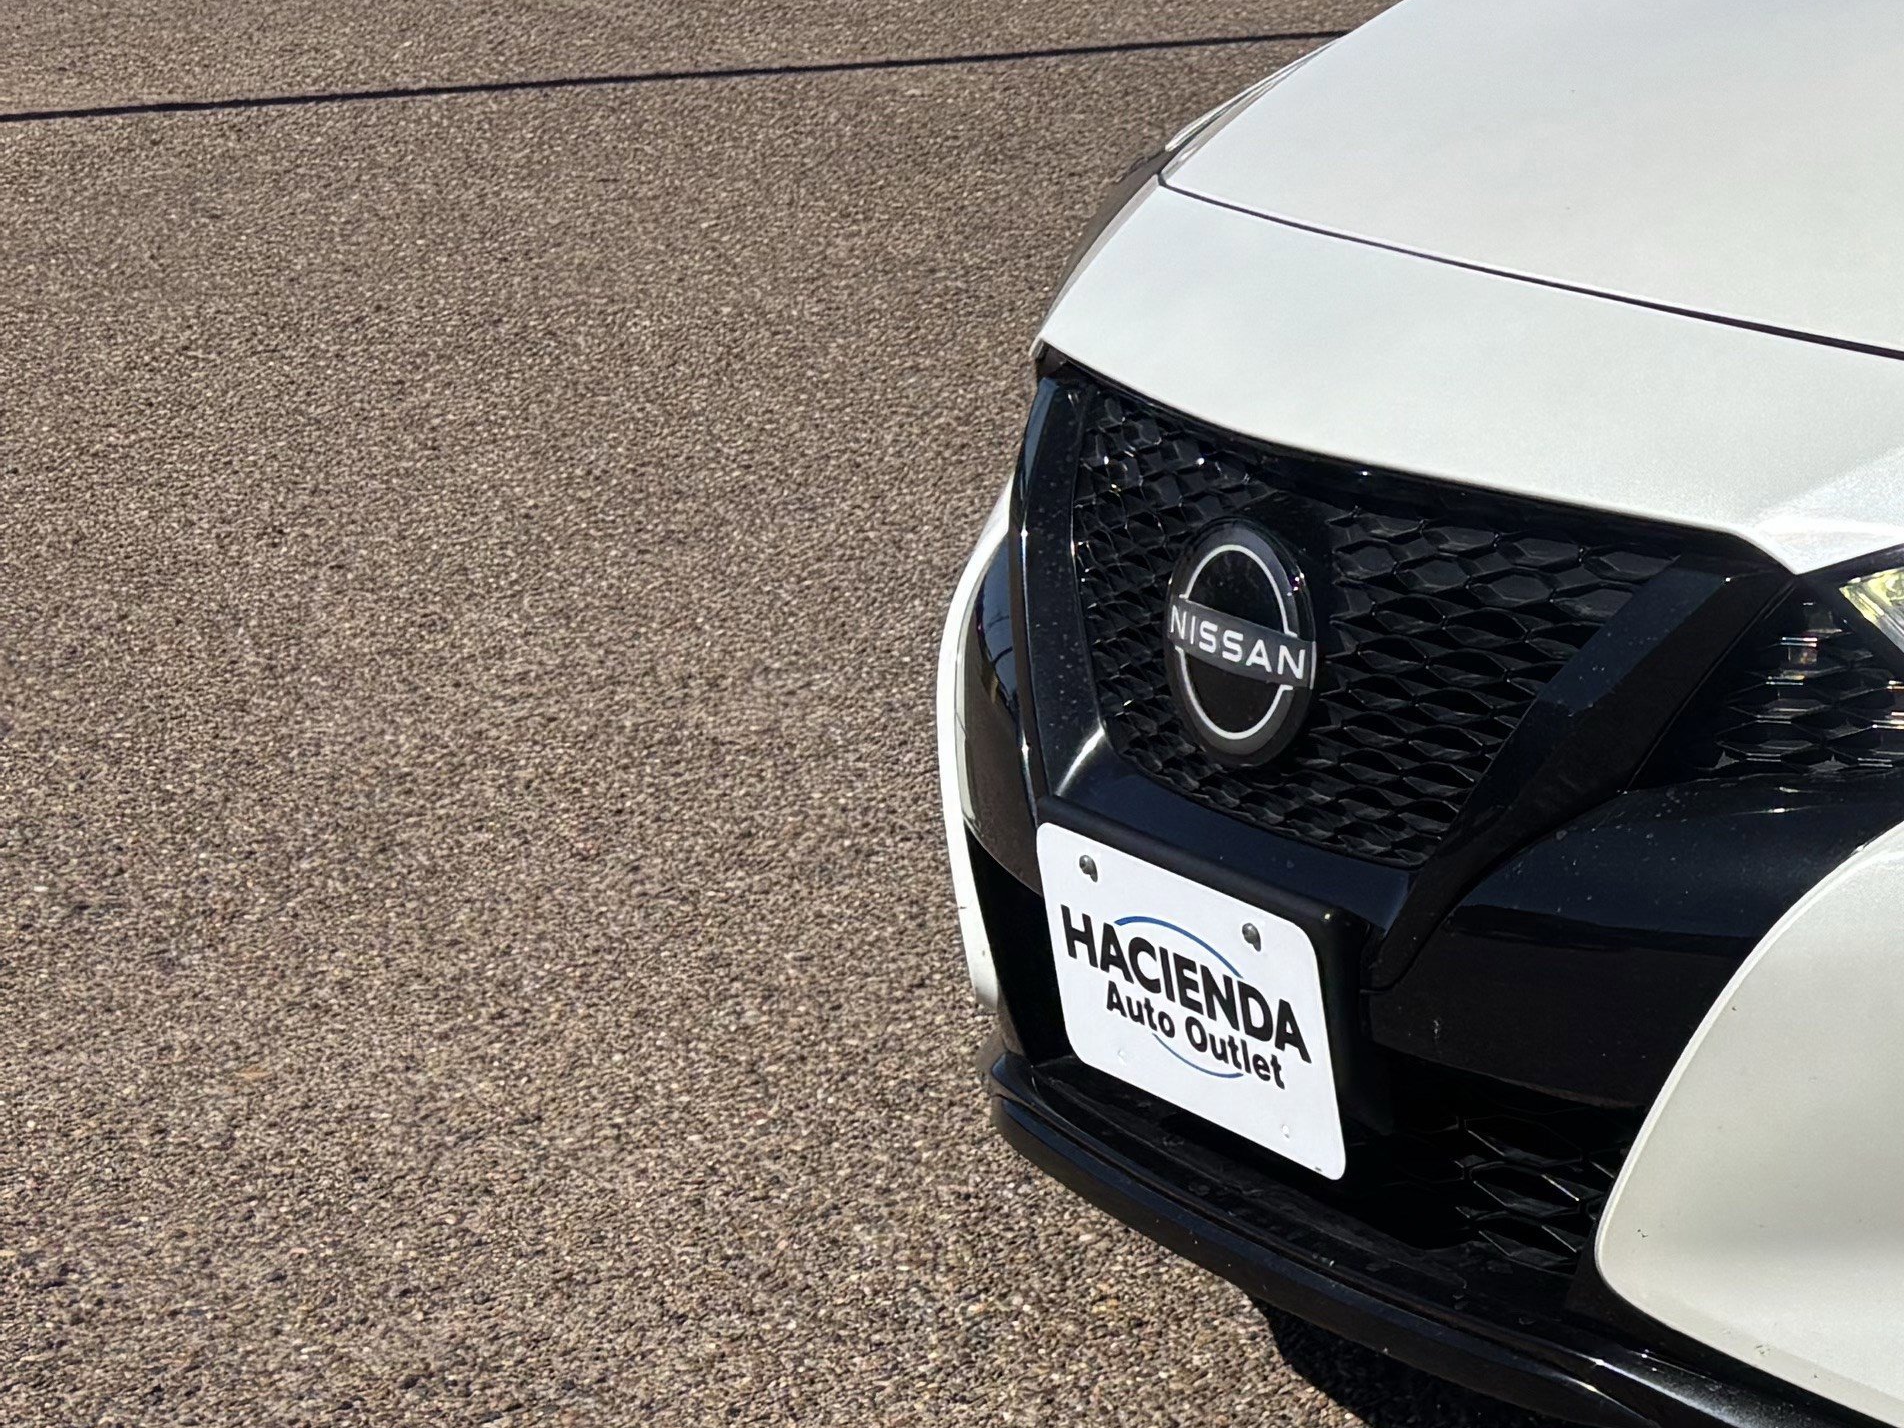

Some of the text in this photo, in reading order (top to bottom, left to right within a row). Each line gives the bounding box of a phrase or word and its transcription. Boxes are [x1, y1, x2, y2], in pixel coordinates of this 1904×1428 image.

[1170, 604, 1306, 680] NISSAN
[1060, 903, 1313, 1065] HACIENDA
[1106, 979, 1286, 1090] Auto Outlet
